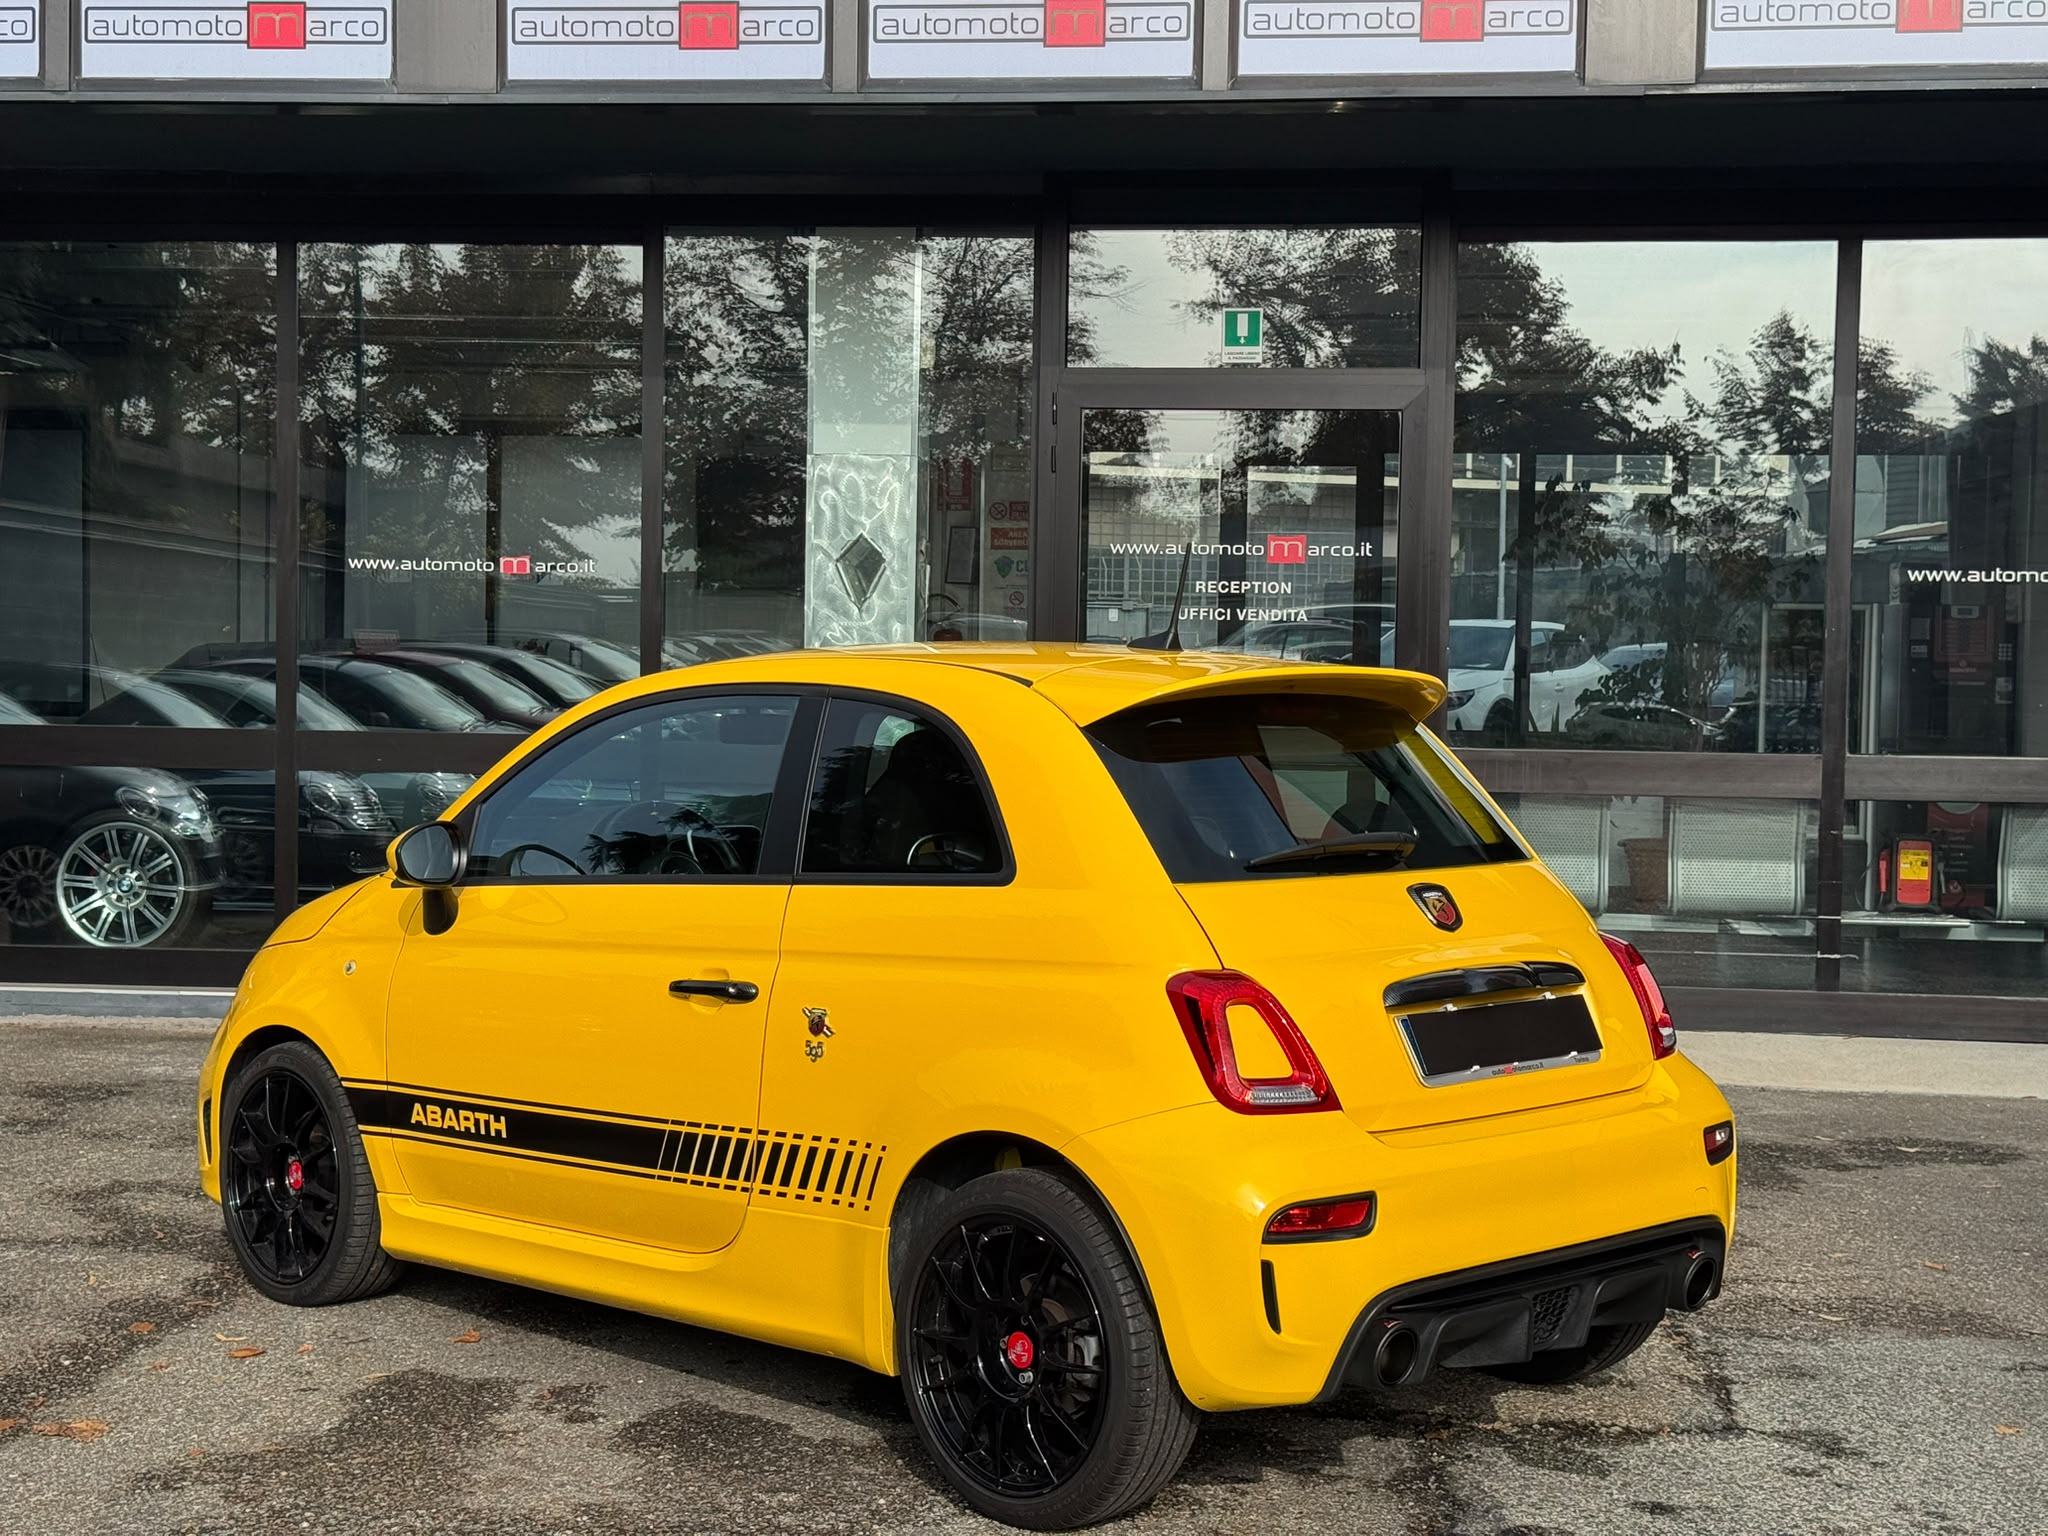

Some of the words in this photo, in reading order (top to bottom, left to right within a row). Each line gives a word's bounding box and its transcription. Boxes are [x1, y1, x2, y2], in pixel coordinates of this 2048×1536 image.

[1195, 580, 1292, 594] RECEPTION
[1236, 608, 1309, 622] VENDITA
[410, 1102, 507, 1139] ABARTH
